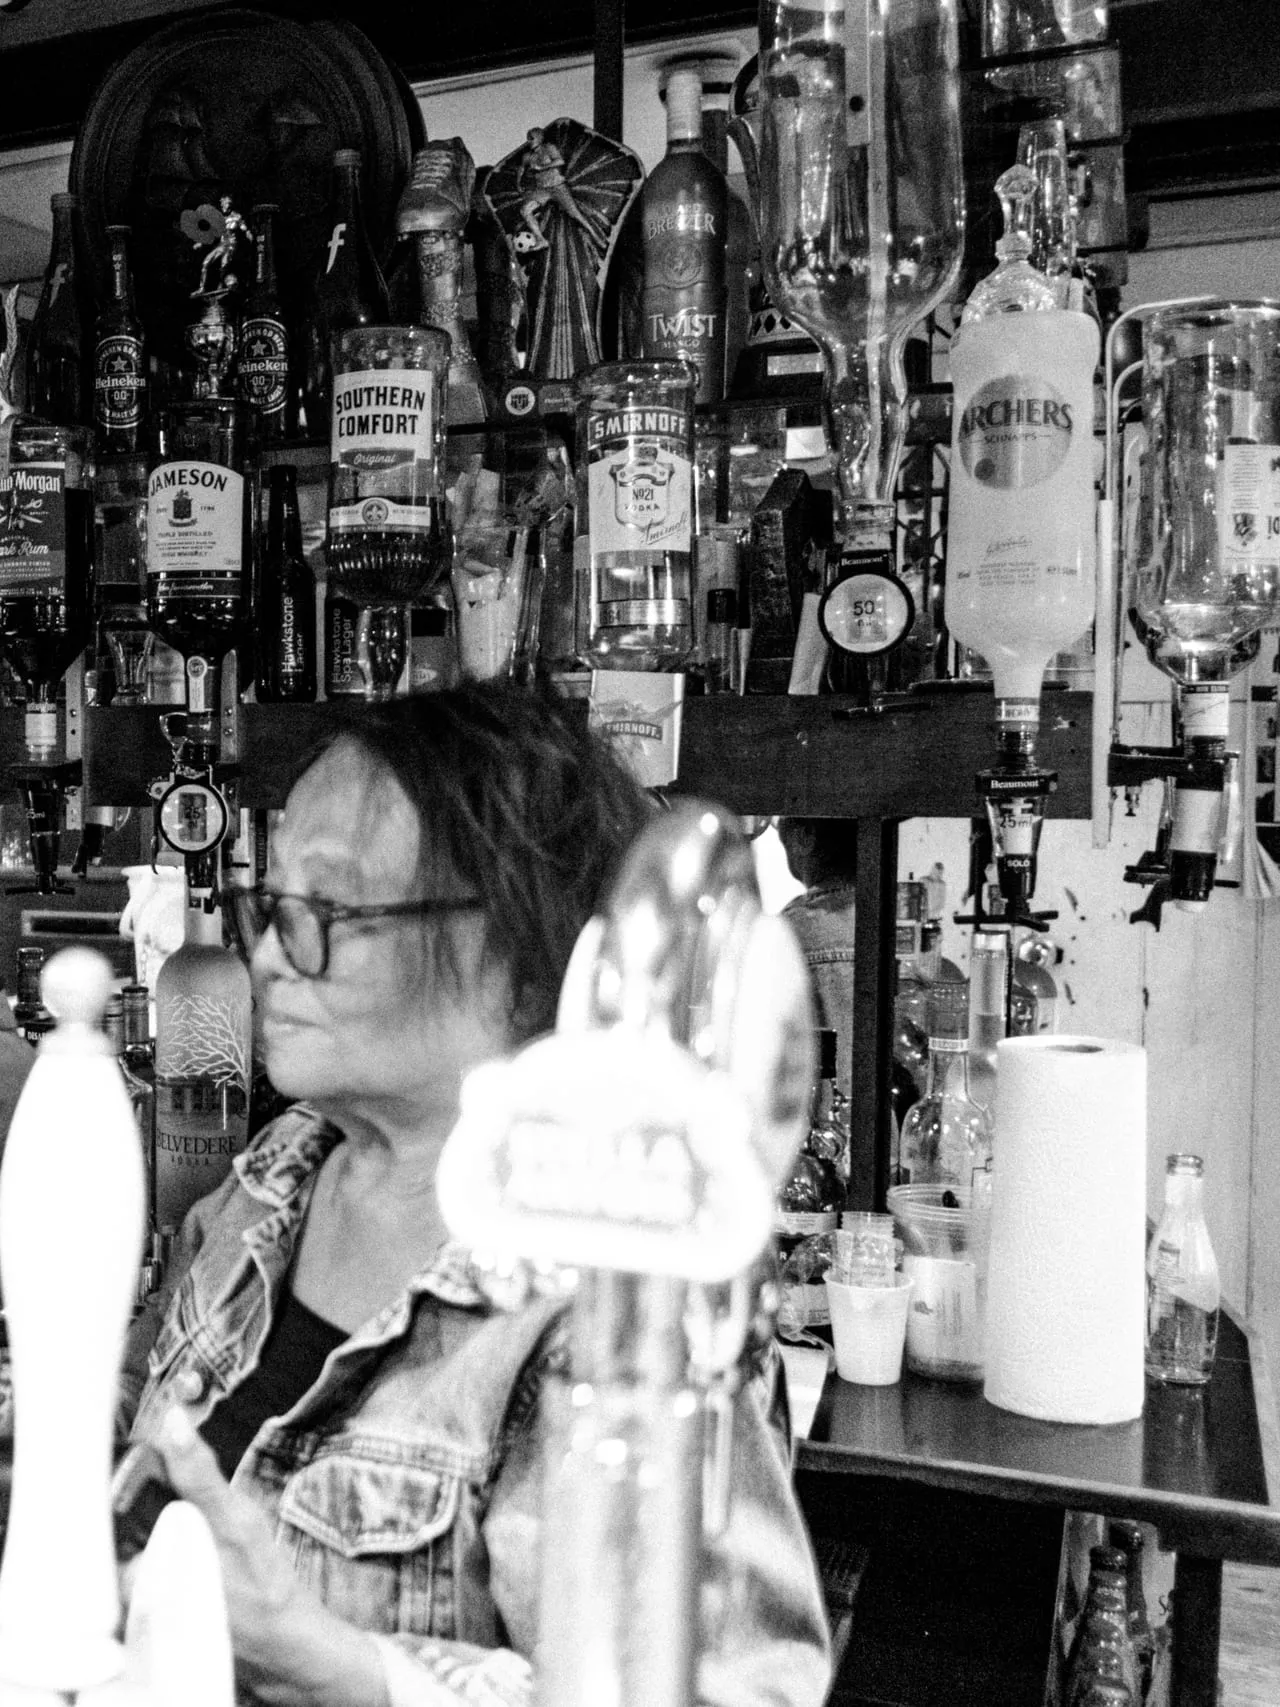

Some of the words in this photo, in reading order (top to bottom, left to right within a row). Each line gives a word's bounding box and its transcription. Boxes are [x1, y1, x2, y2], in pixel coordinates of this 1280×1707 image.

[648, 307, 716, 342] TWIST
[96, 374, 146, 389] Heineken
[336, 386, 426, 415] SOUTHERN
[338, 413, 419, 438] COMFORT
[595, 412, 686, 439] SMIRNOFF
[961, 398, 1074, 435] ARCHERS
[984, 432, 1037, 445] SCHNAPS
[353, 453, 397, 466] Original
[14, 470, 61, 494] Morgan
[150, 468, 228, 497] JAMESON
[17, 541, 49, 556] Rum
[853, 600, 875, 616] 50
[282, 596, 294, 673] Hawkstone
[332, 608, 342, 684] Hawkstone
[342, 618, 354, 655] Lager
[342, 656, 353, 683] Spa
[991, 780, 1039, 789] Beaumont
[1000, 818, 1017, 829] 25
[1007, 859, 1031, 868] SOLO
[156, 1128, 238, 1156] BELVEDERE
